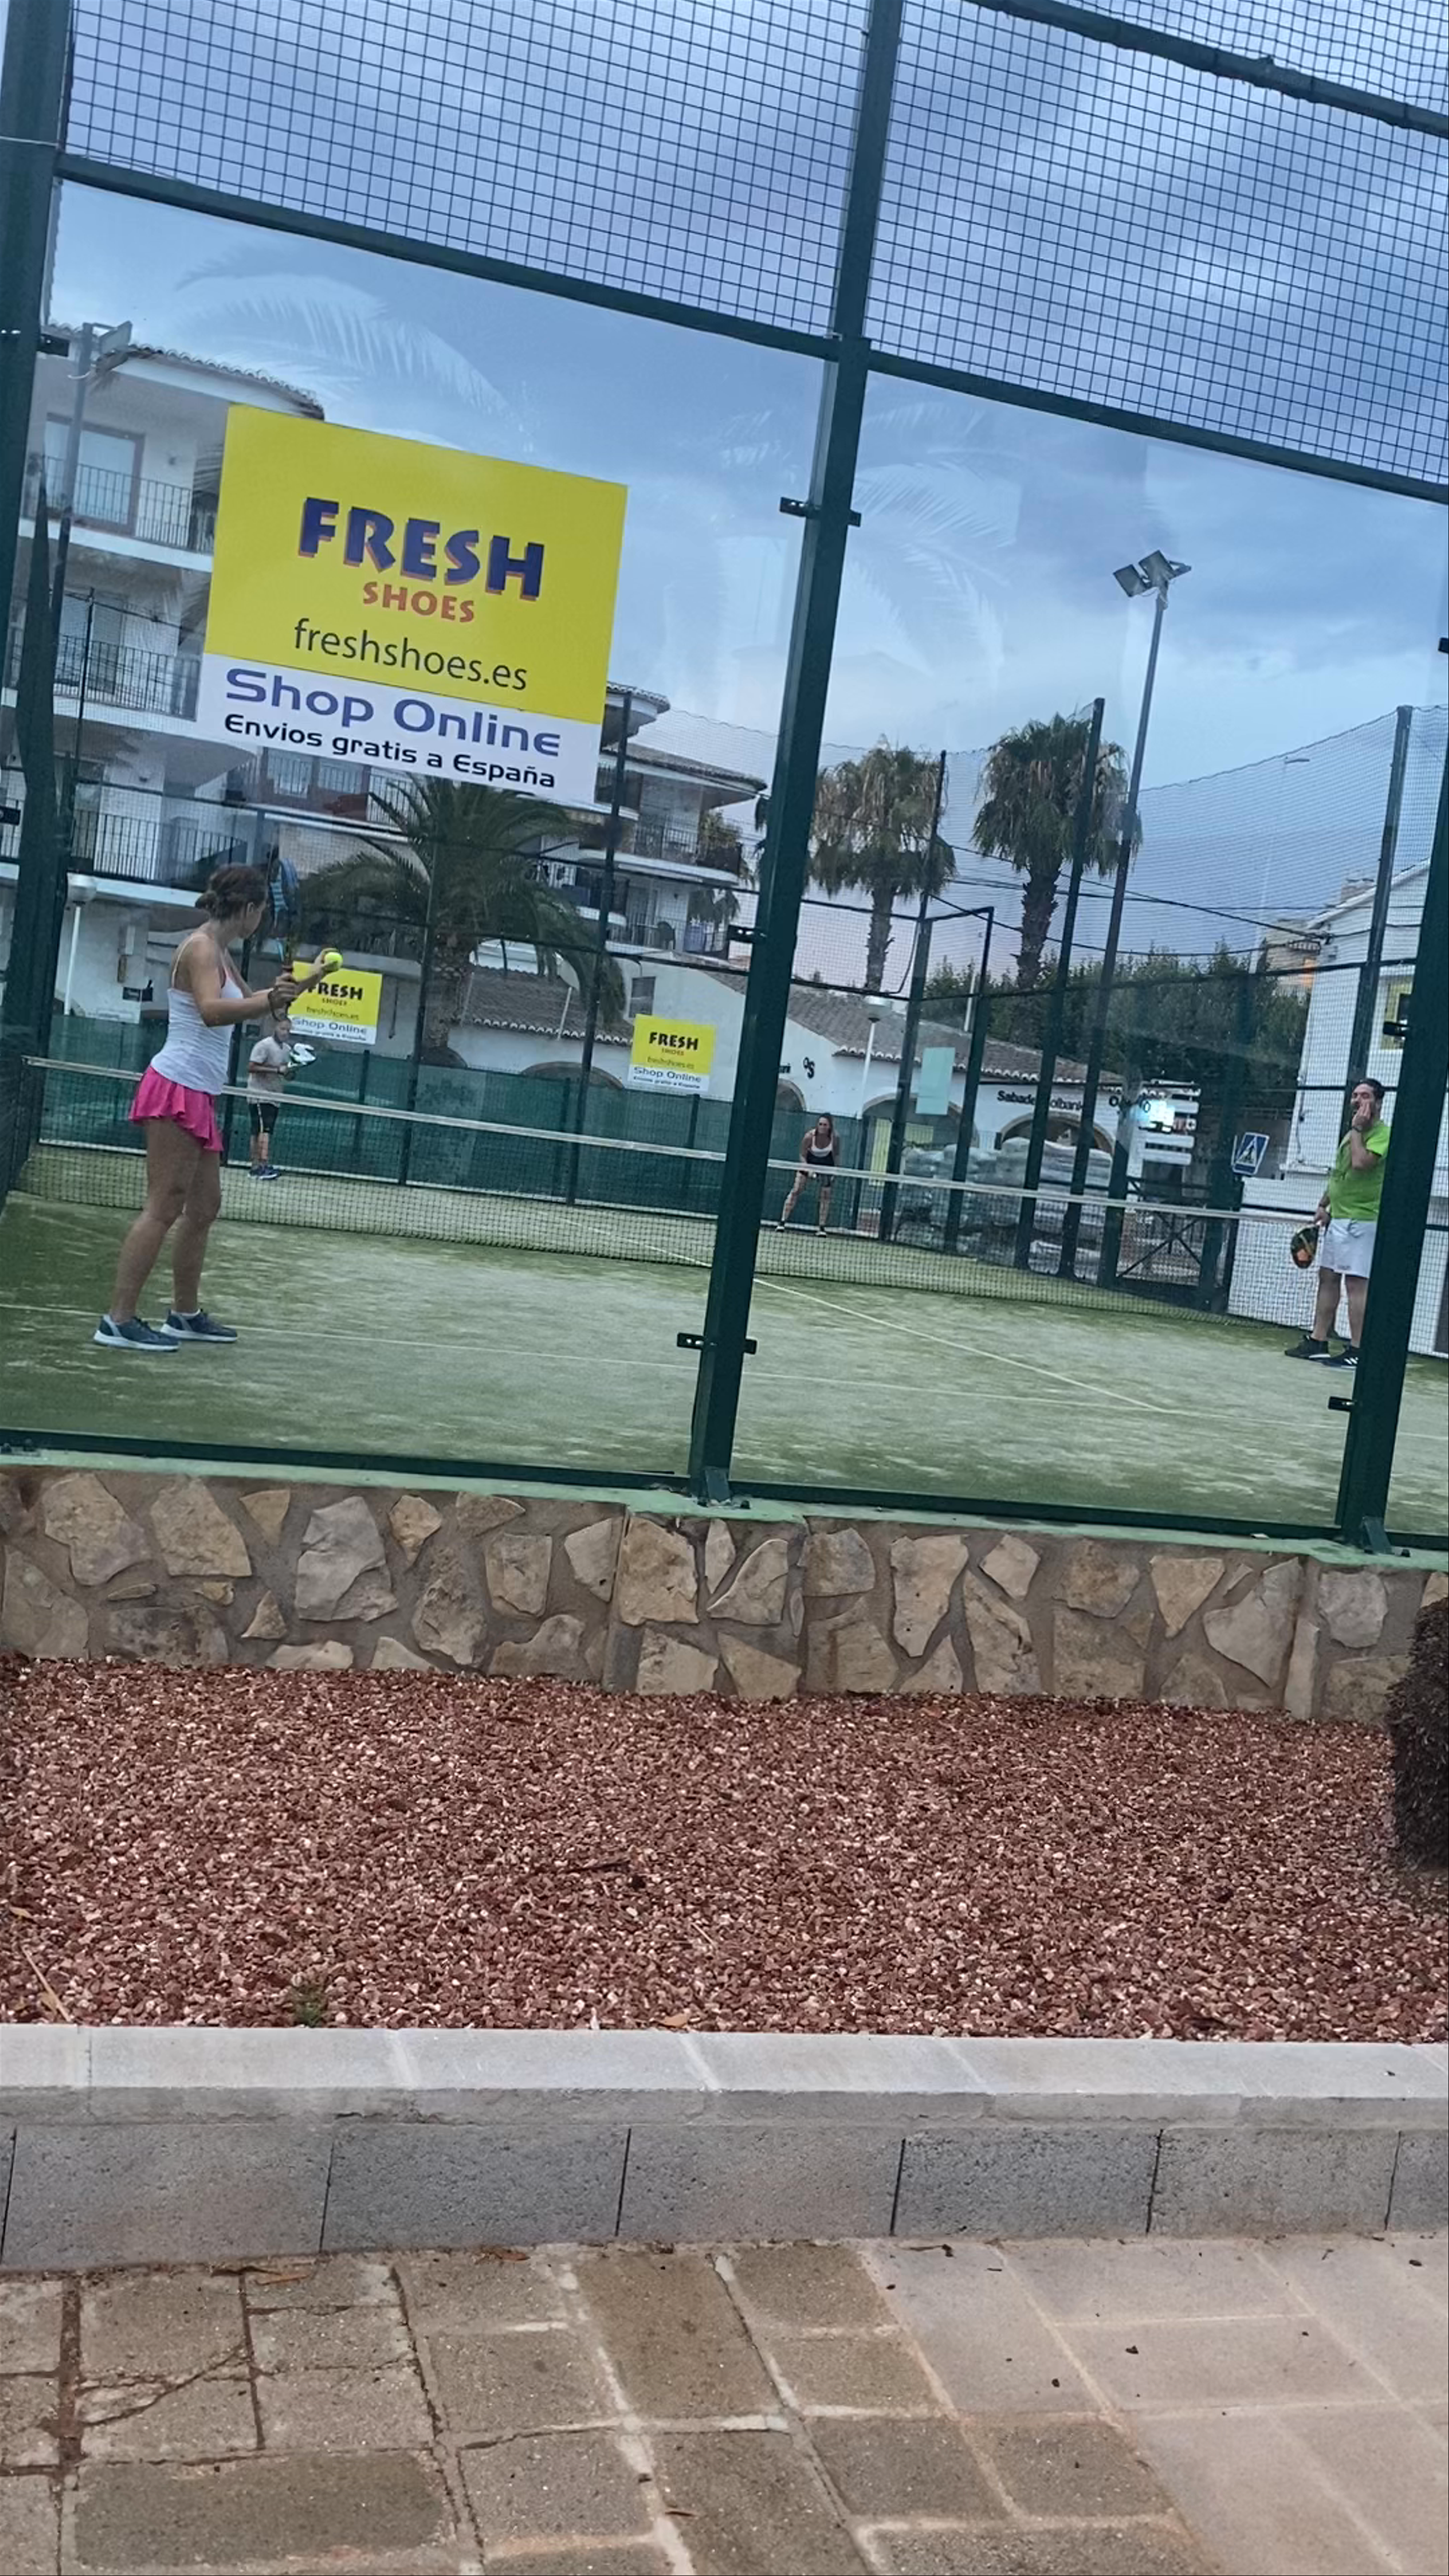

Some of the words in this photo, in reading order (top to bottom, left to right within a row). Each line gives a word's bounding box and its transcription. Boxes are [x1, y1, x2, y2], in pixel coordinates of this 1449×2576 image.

[298, 497, 545, 601] FRESH
[363, 581, 475, 623] SHOES
[294, 618, 528, 690] freshshoes.es
[226, 668, 374, 727] Shop
[394, 699, 560, 757] Online
[225, 714, 322, 747] Envios
[332, 737, 417, 764] gratis
[427, 753, 442, 768] a
[453, 754, 555, 787] España
[329, 1022, 366, 1035] Online
[649, 1032, 698, 1050] FRESH
[634, 1067, 663, 1078] Shop
[667, 1071, 701, 1083] Online
